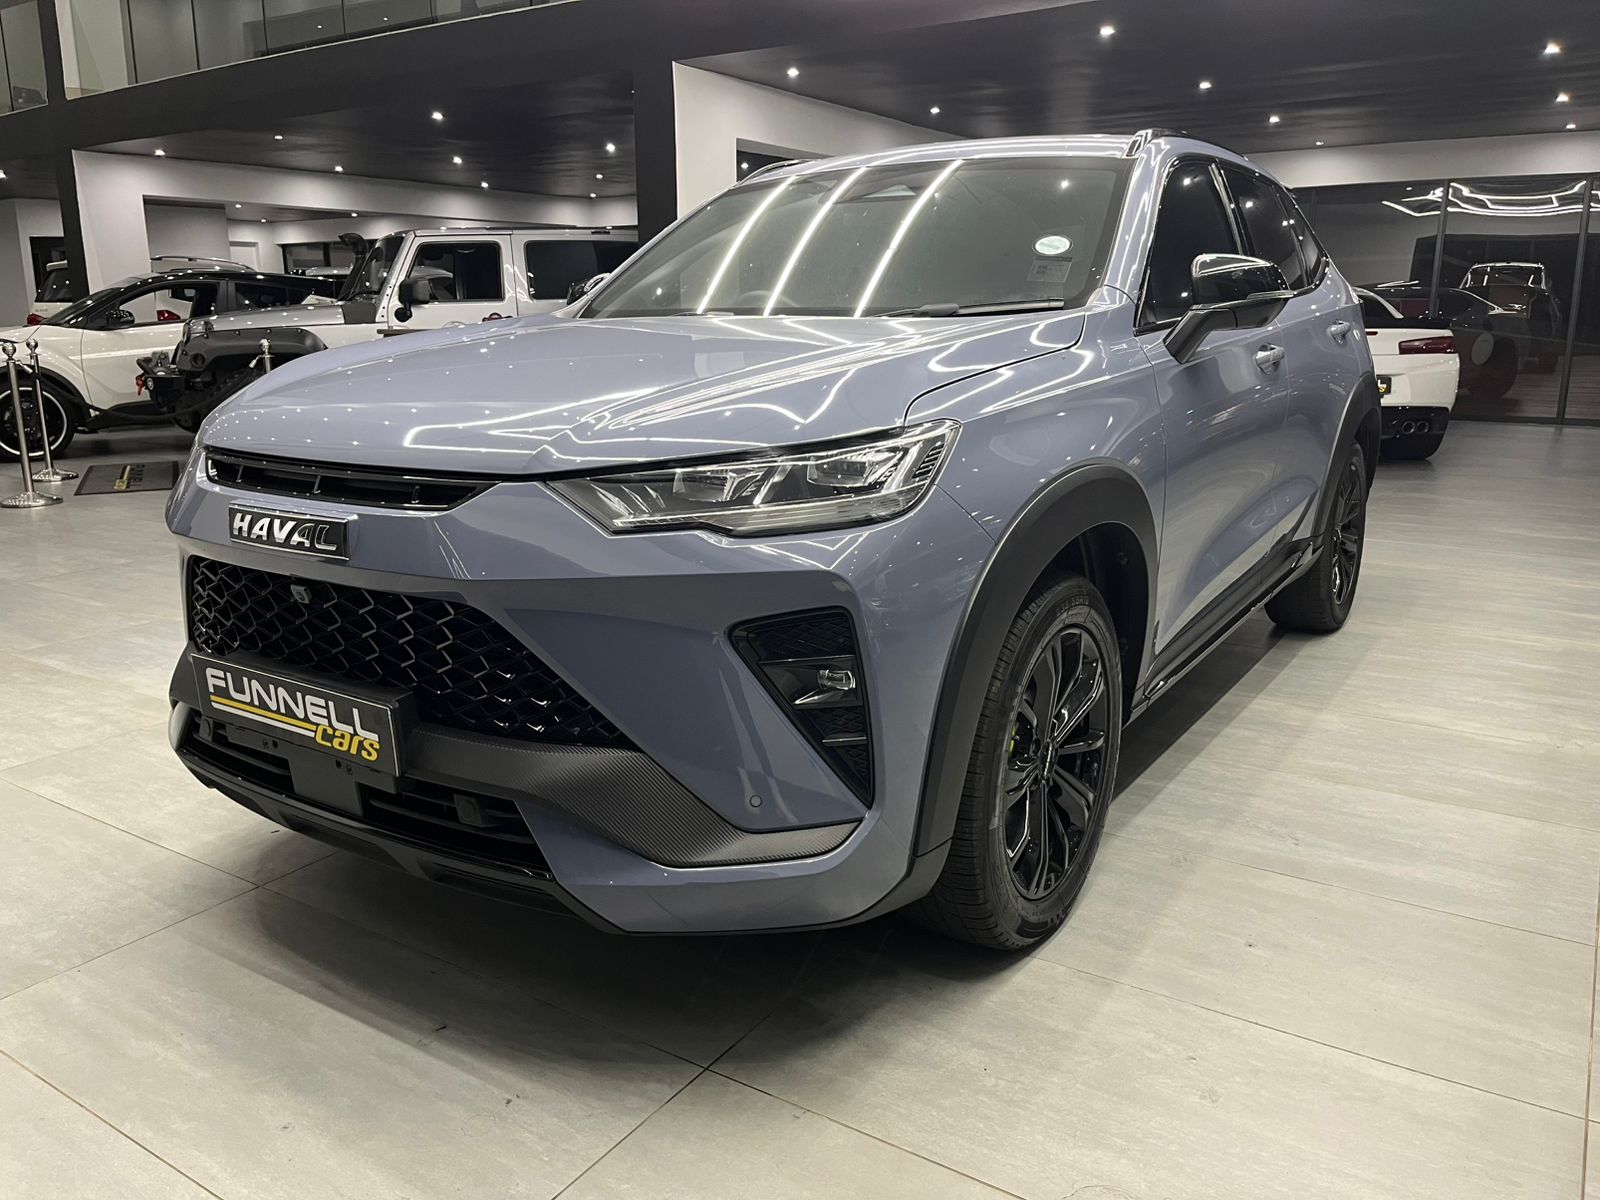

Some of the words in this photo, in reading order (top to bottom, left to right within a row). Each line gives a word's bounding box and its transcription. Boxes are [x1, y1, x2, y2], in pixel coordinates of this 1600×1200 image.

[232, 512, 337, 551] HAVAL
[205, 667, 379, 741] FUNNELL
[315, 725, 380, 761] cars
